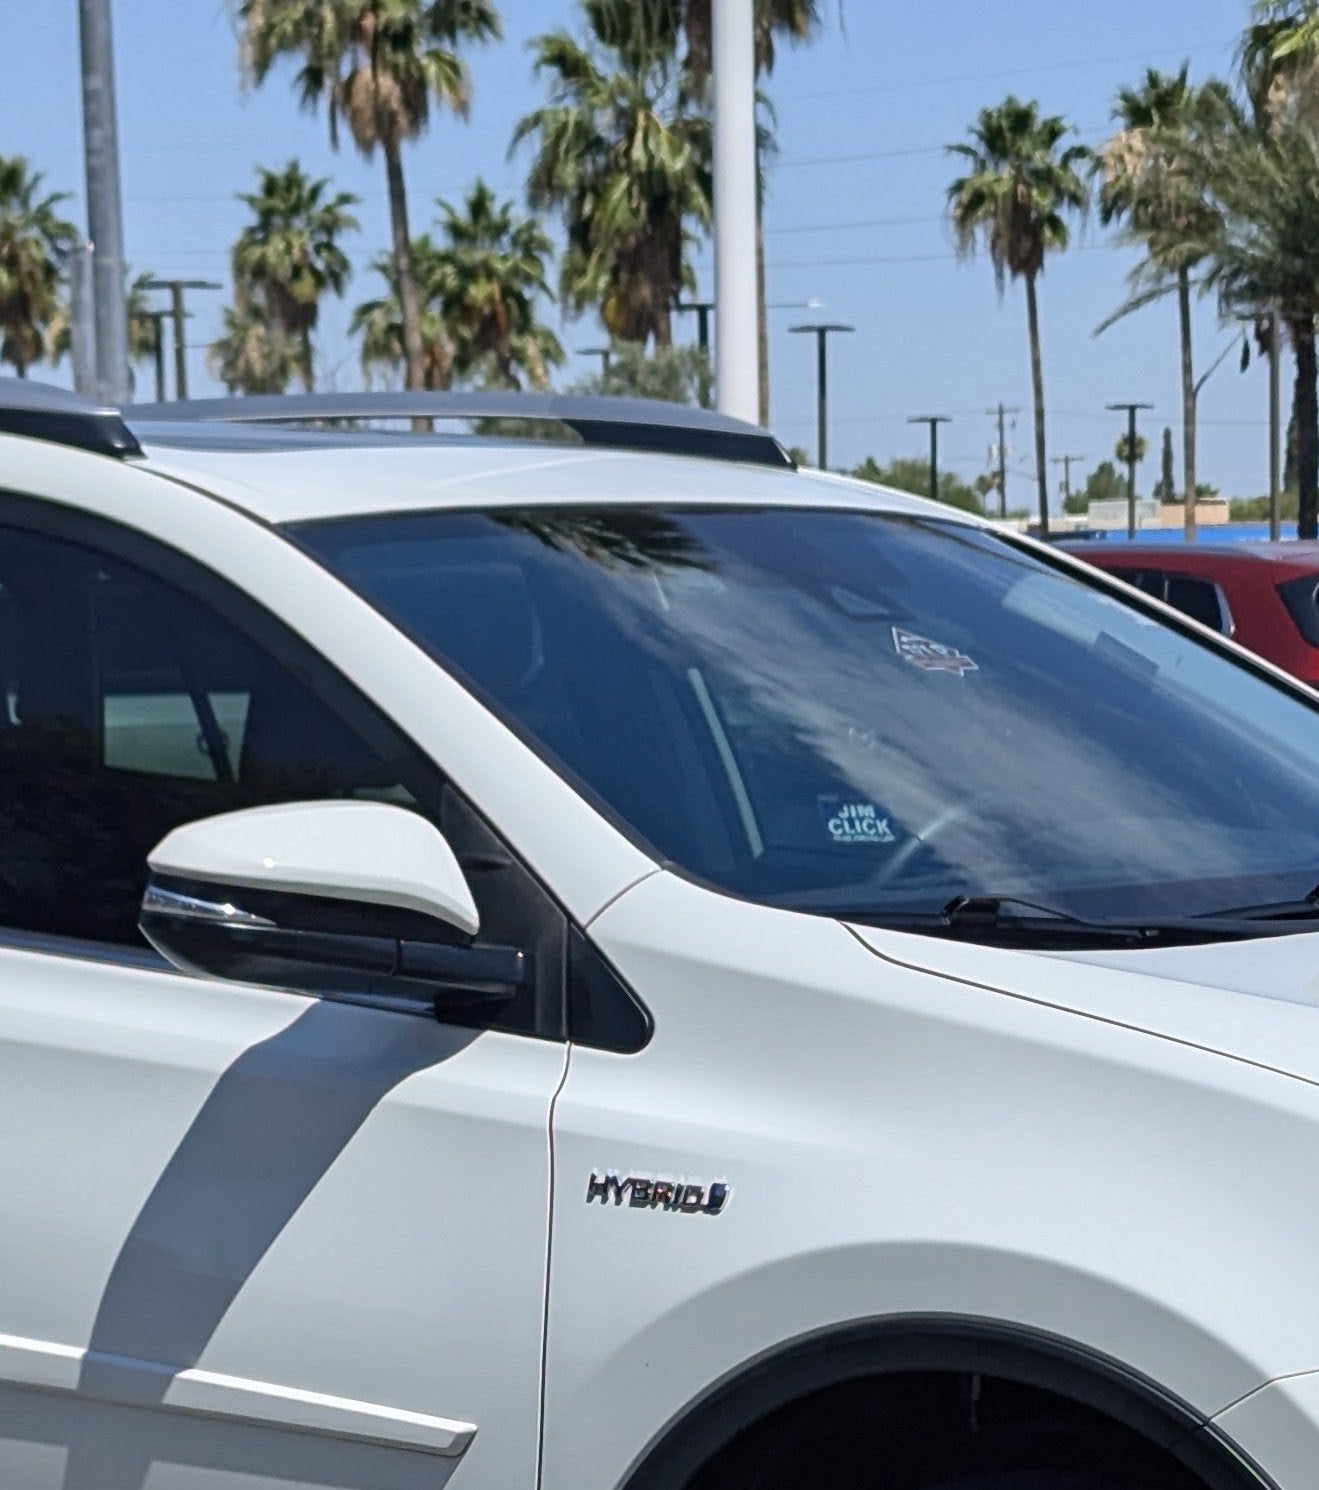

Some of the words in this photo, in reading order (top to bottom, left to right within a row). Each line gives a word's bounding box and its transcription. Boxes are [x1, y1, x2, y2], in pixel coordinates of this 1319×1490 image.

[838, 804, 875, 818] JIM
[827, 818, 891, 835] CLICK
[585, 1170, 706, 1214] HYBRID
